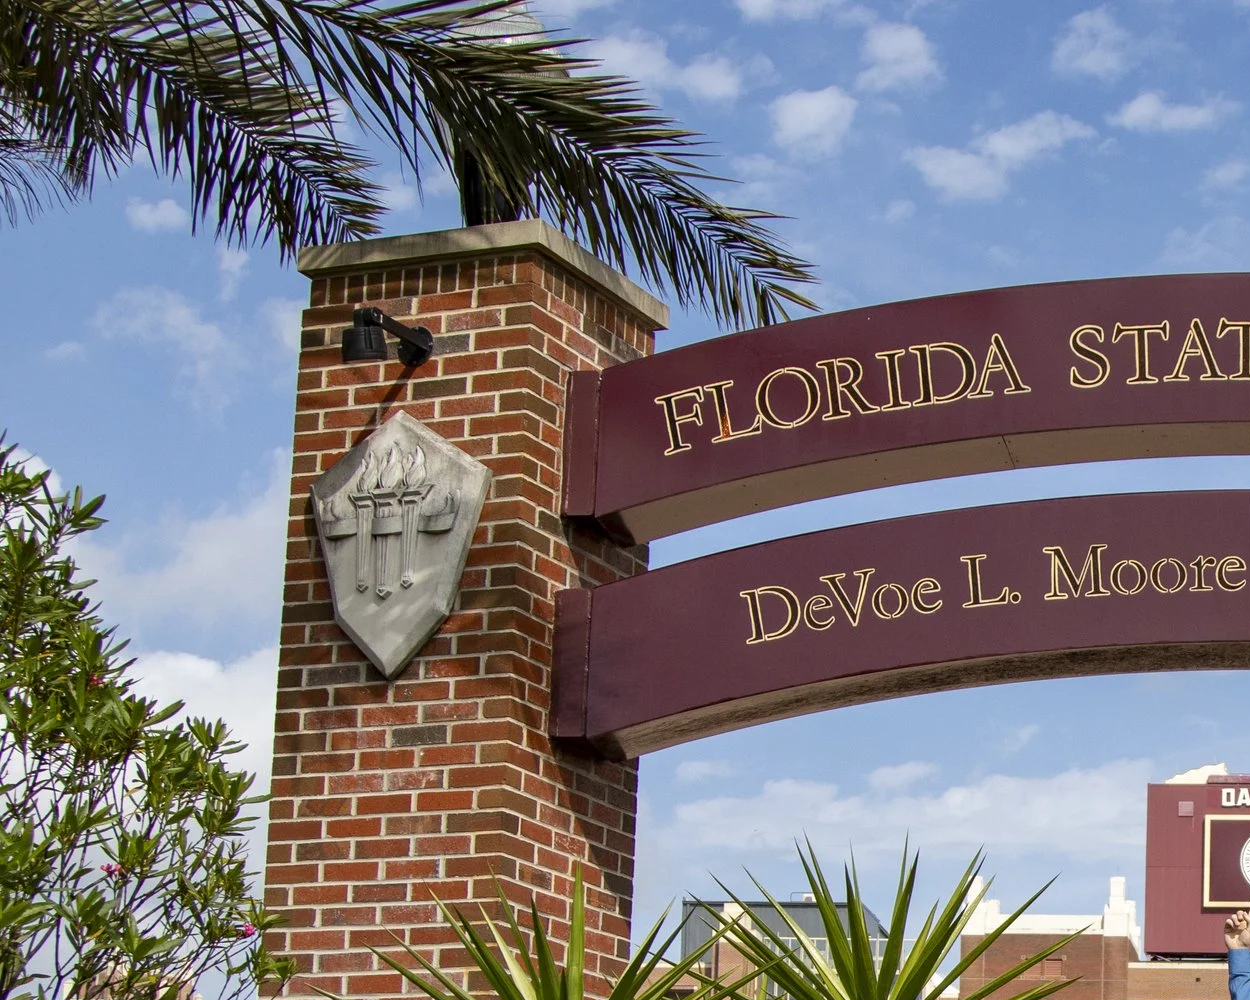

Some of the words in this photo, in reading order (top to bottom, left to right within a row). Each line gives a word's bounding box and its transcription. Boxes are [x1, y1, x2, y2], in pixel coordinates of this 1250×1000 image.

[655, 333, 1032, 456] FLORIDA
[740, 568, 943, 645] DeVoe
[960, 554, 1022, 610] L.
[1043, 543, 1248, 602] Moore
